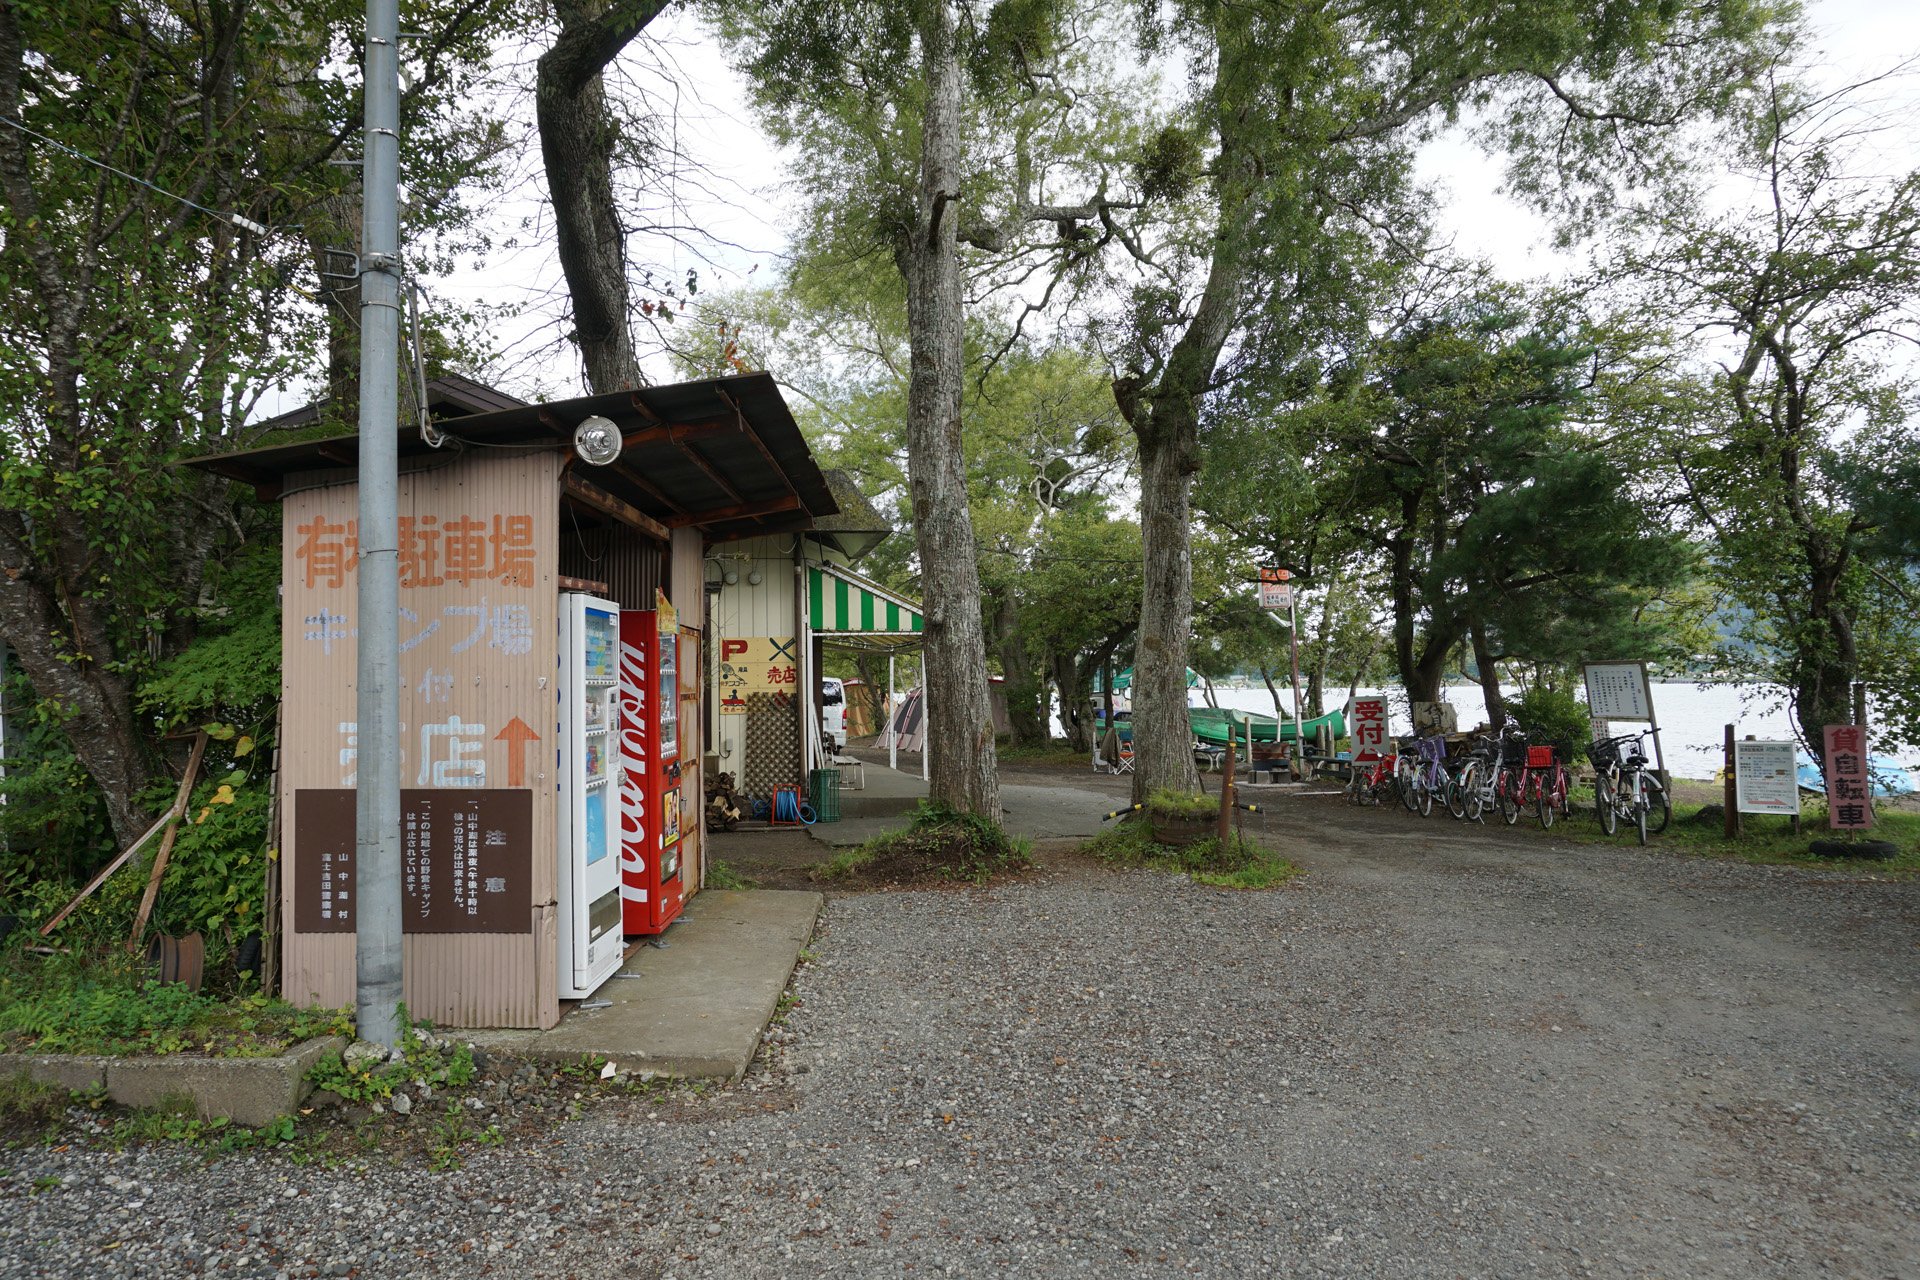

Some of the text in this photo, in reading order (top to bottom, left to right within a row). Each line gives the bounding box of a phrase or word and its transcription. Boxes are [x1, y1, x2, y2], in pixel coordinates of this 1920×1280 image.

[304, 596, 534, 655] キンプ場
[722, 639, 748, 661] P
[767, 665, 797, 684] 売店
[1355, 700, 1385, 745] 受付
[1831, 728, 1865, 826] 貸自転車
[338, 853, 349, 919] 山中湖村
[485, 829, 507, 892] 注意
